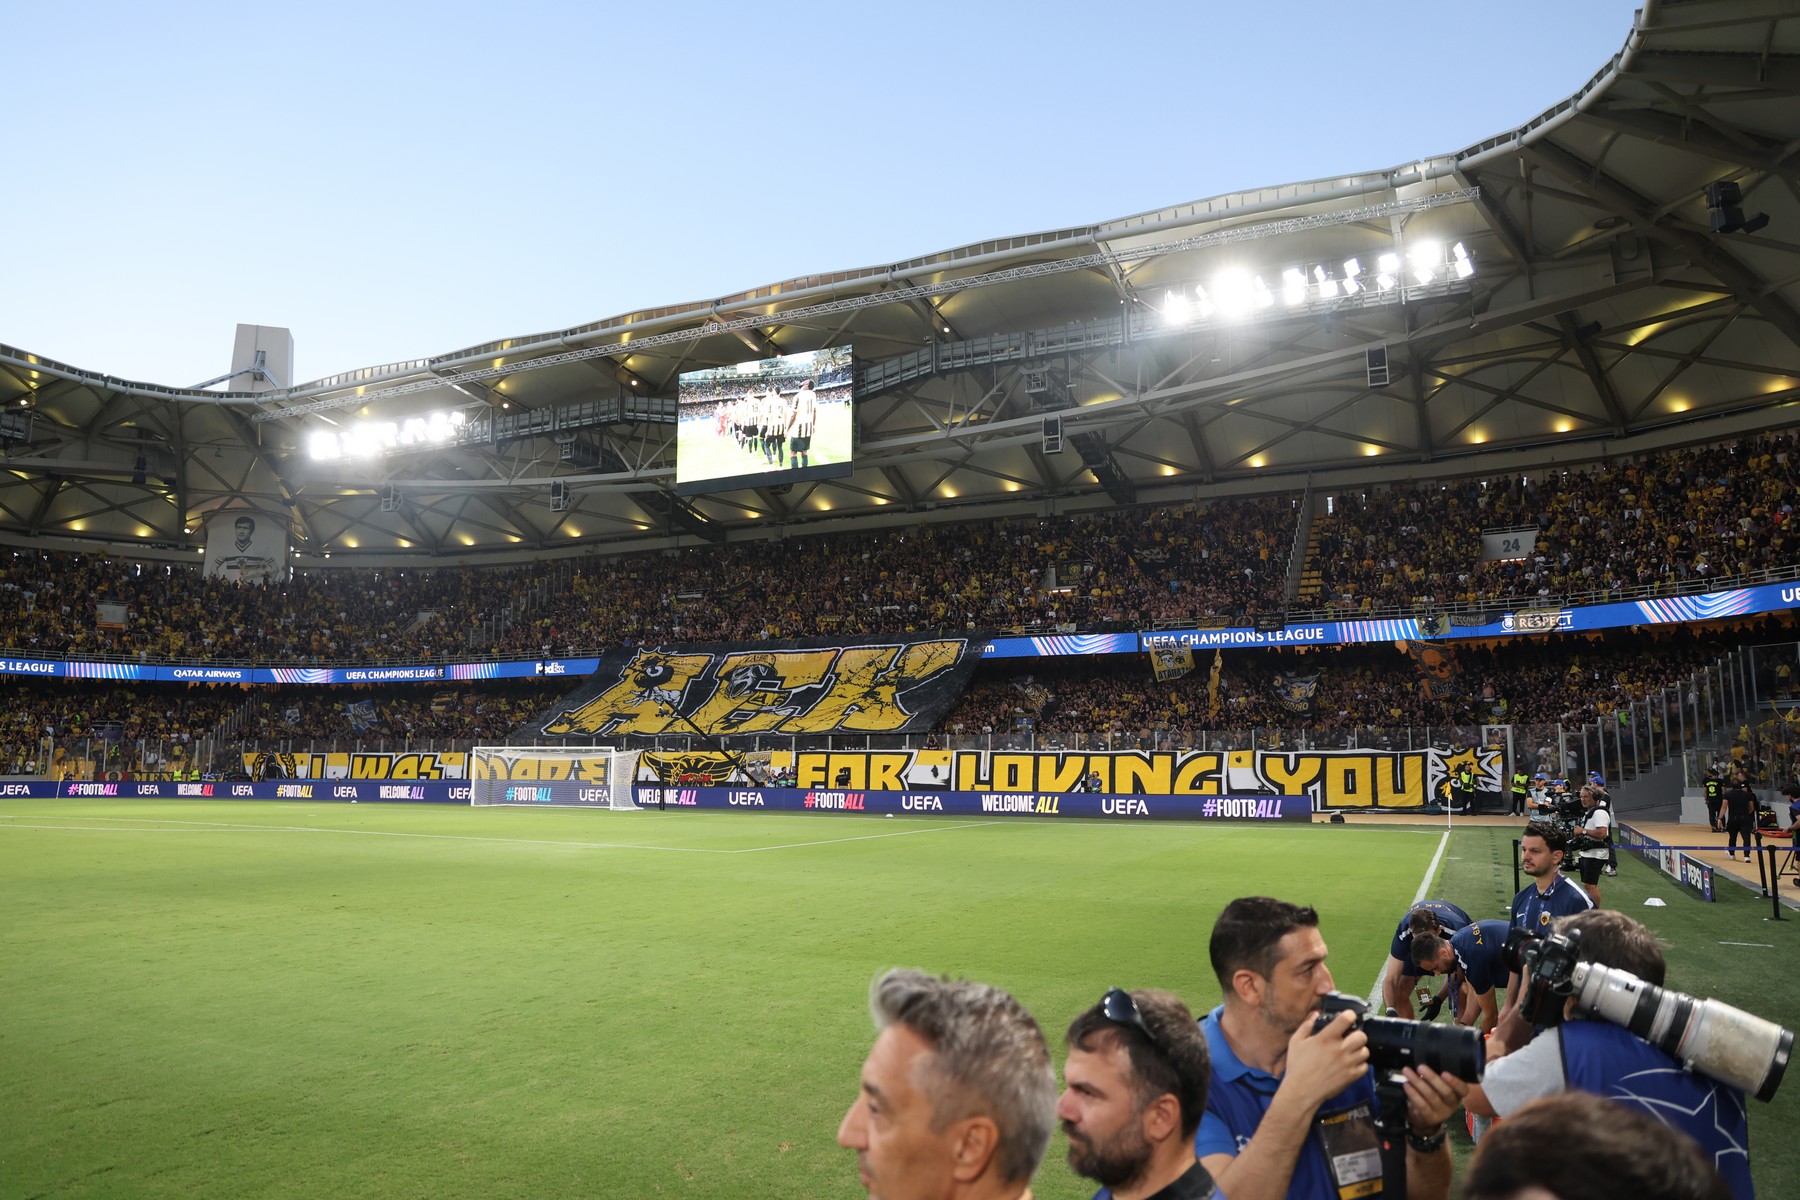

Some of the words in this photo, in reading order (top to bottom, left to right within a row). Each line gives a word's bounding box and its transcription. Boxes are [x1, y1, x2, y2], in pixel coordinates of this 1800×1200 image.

[1503, 538, 1520, 552] 24
[1519, 614, 1572, 629] RESPECT
[1180, 631, 1265, 646] CHAMPIONS
[1267, 627, 1324, 642] LEAGUE
[8, 662, 55, 673] LEAGUE
[173, 669, 203, 678] QATAR
[204, 670, 242, 679] AIRWAYS
[346, 671, 367, 680] UEFA
[367, 669, 415, 680] CHAMPIONS
[415, 667, 444, 679] LEAGUE
[1264, 756, 1424, 807] YOU
[67, 783, 118, 796] #FOOTBALL
[137, 784, 160, 795] UEFA
[231, 785, 254, 796] UEFA
[276, 785, 313, 798] #FOOTBALL
[333, 786, 358, 798] UEFA
[505, 787, 552, 802] #FOOTBALL
[579, 788, 610, 802] UEFA
[728, 791, 765, 806] UEFA
[803, 791, 865, 810] #FOOTBALL
[901, 795, 943, 811] UEFA
[1101, 798, 1149, 815] UEFA
[1201, 797, 1283, 818] #FOOTBALL
[1687, 864, 1703, 890] PEPSI
